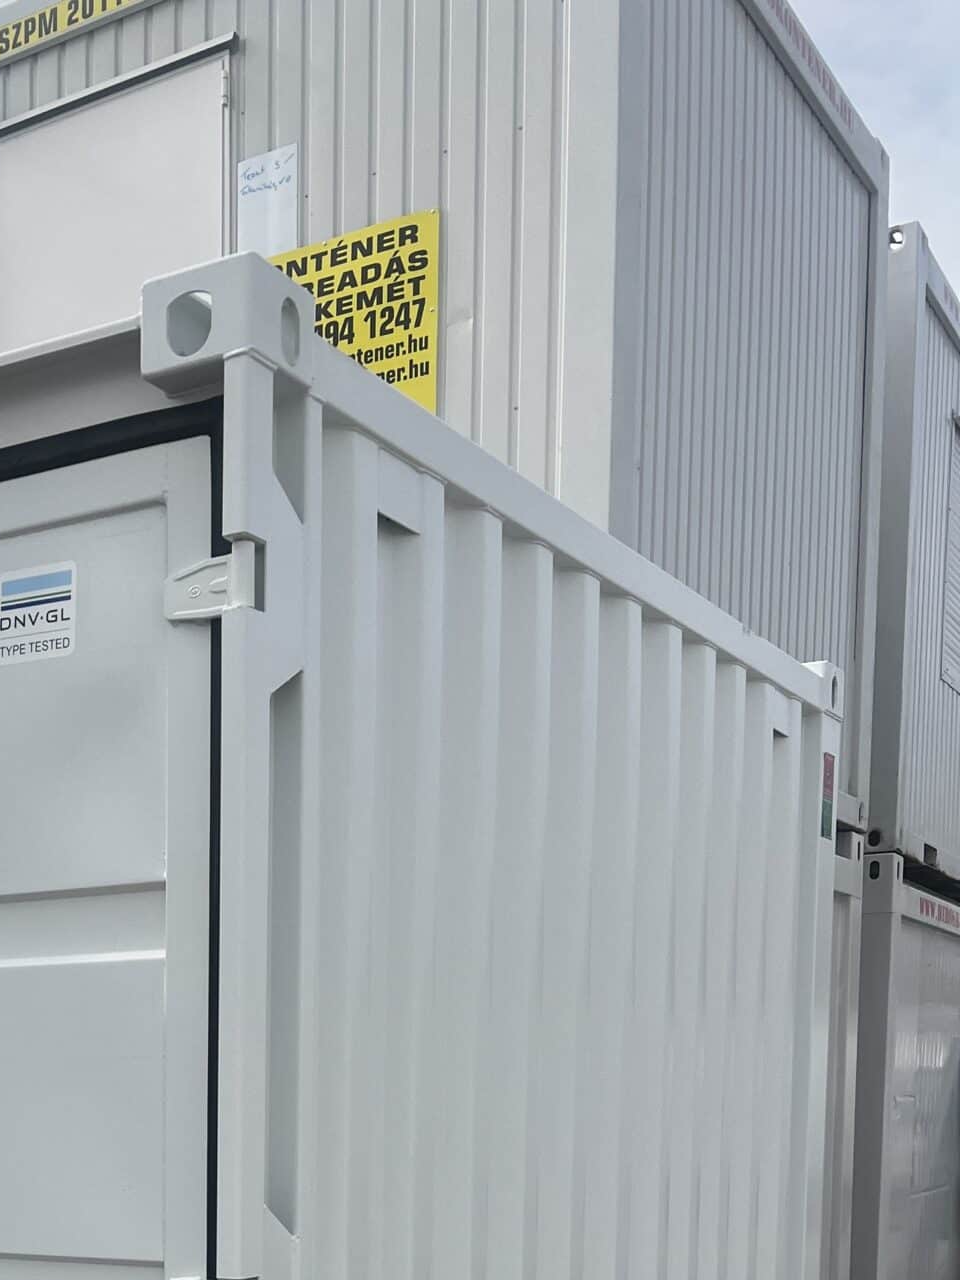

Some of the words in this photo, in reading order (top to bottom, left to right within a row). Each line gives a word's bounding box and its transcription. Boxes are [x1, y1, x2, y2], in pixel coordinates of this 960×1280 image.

[315, 275, 426, 322] KEMÉT
[364, 298, 426, 339] 1247
[0, 643, 26, 658] TYPE
[28, 636, 71, 653] TESTED
